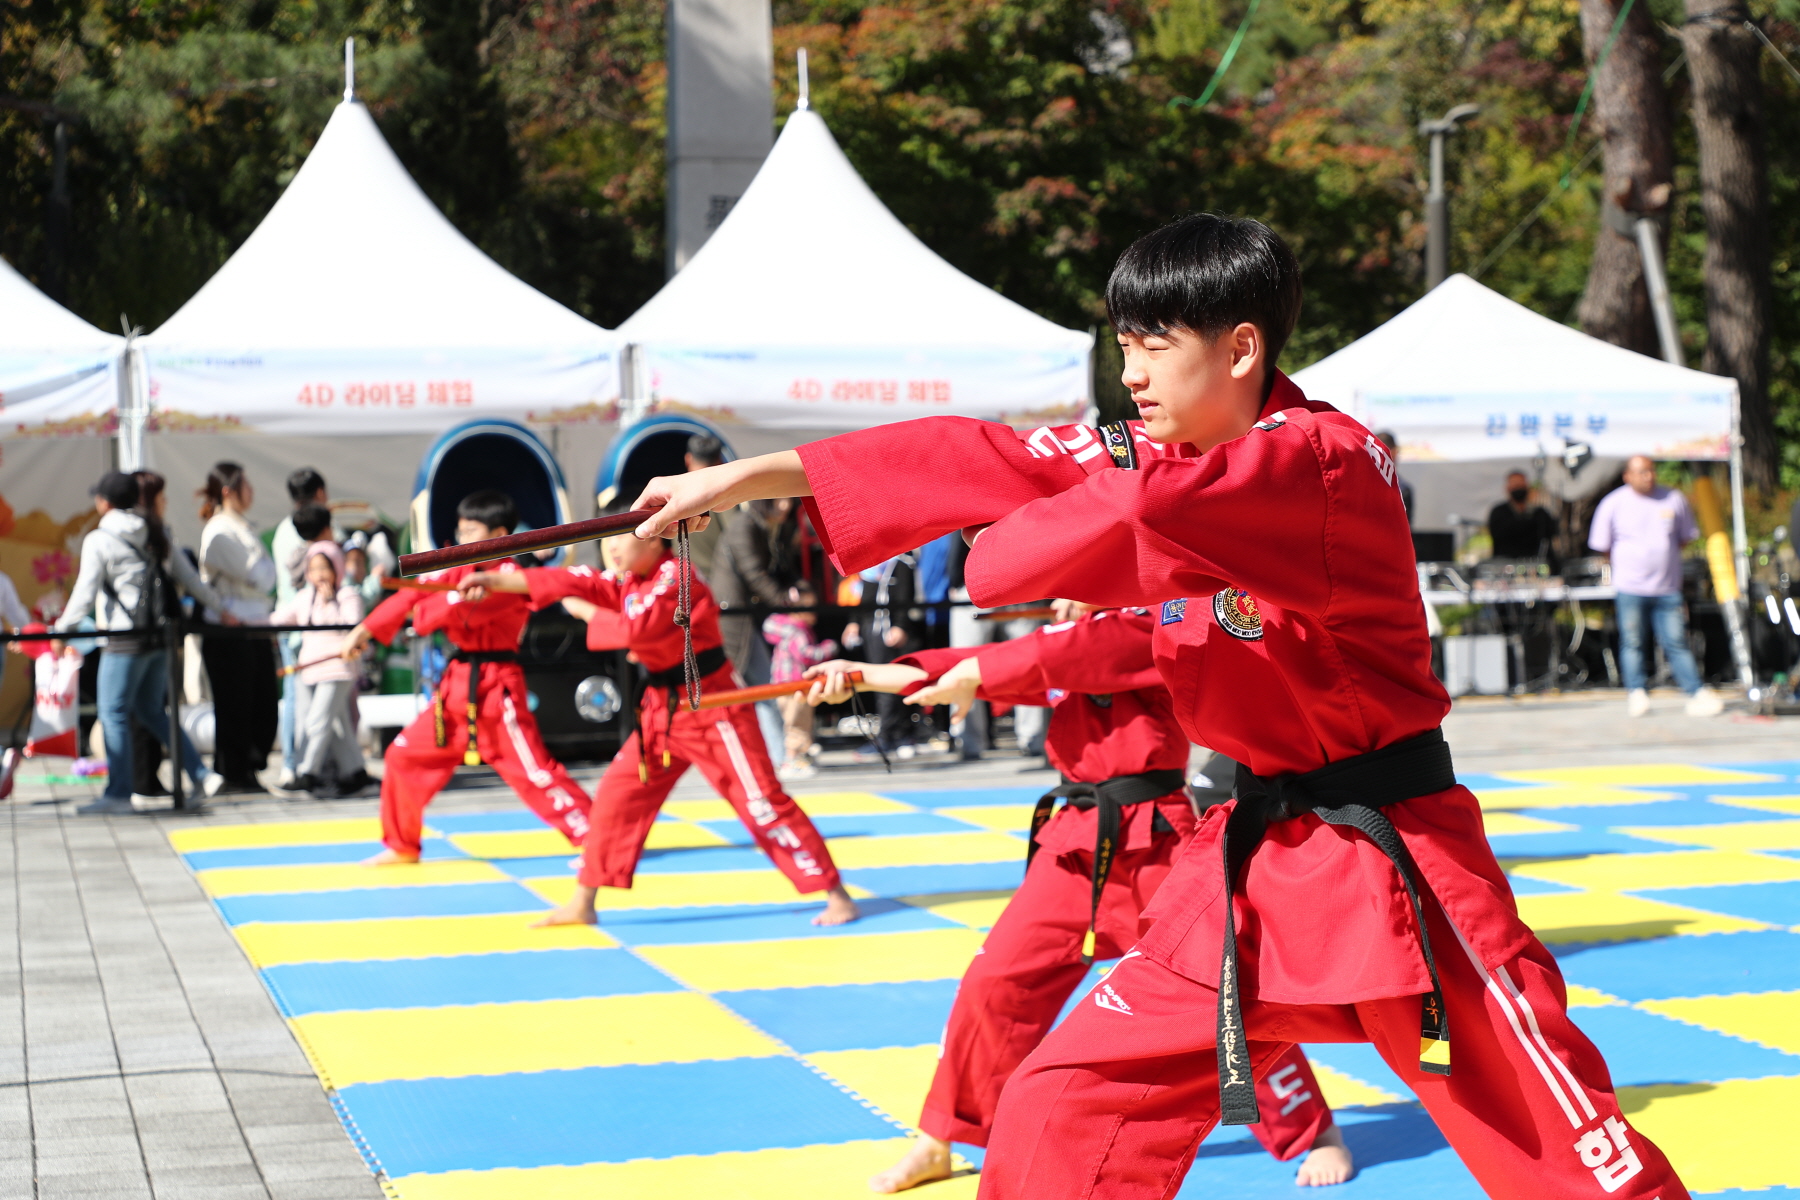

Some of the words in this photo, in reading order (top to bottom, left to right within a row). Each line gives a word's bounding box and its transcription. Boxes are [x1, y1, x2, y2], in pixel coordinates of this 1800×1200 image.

[298, 382, 334, 406] 4D
[344, 381, 415, 408] 라이딩
[427, 379, 473, 406] 체험
[787, 379, 823, 402] 4D
[1573, 1115, 1644, 1193] 합
